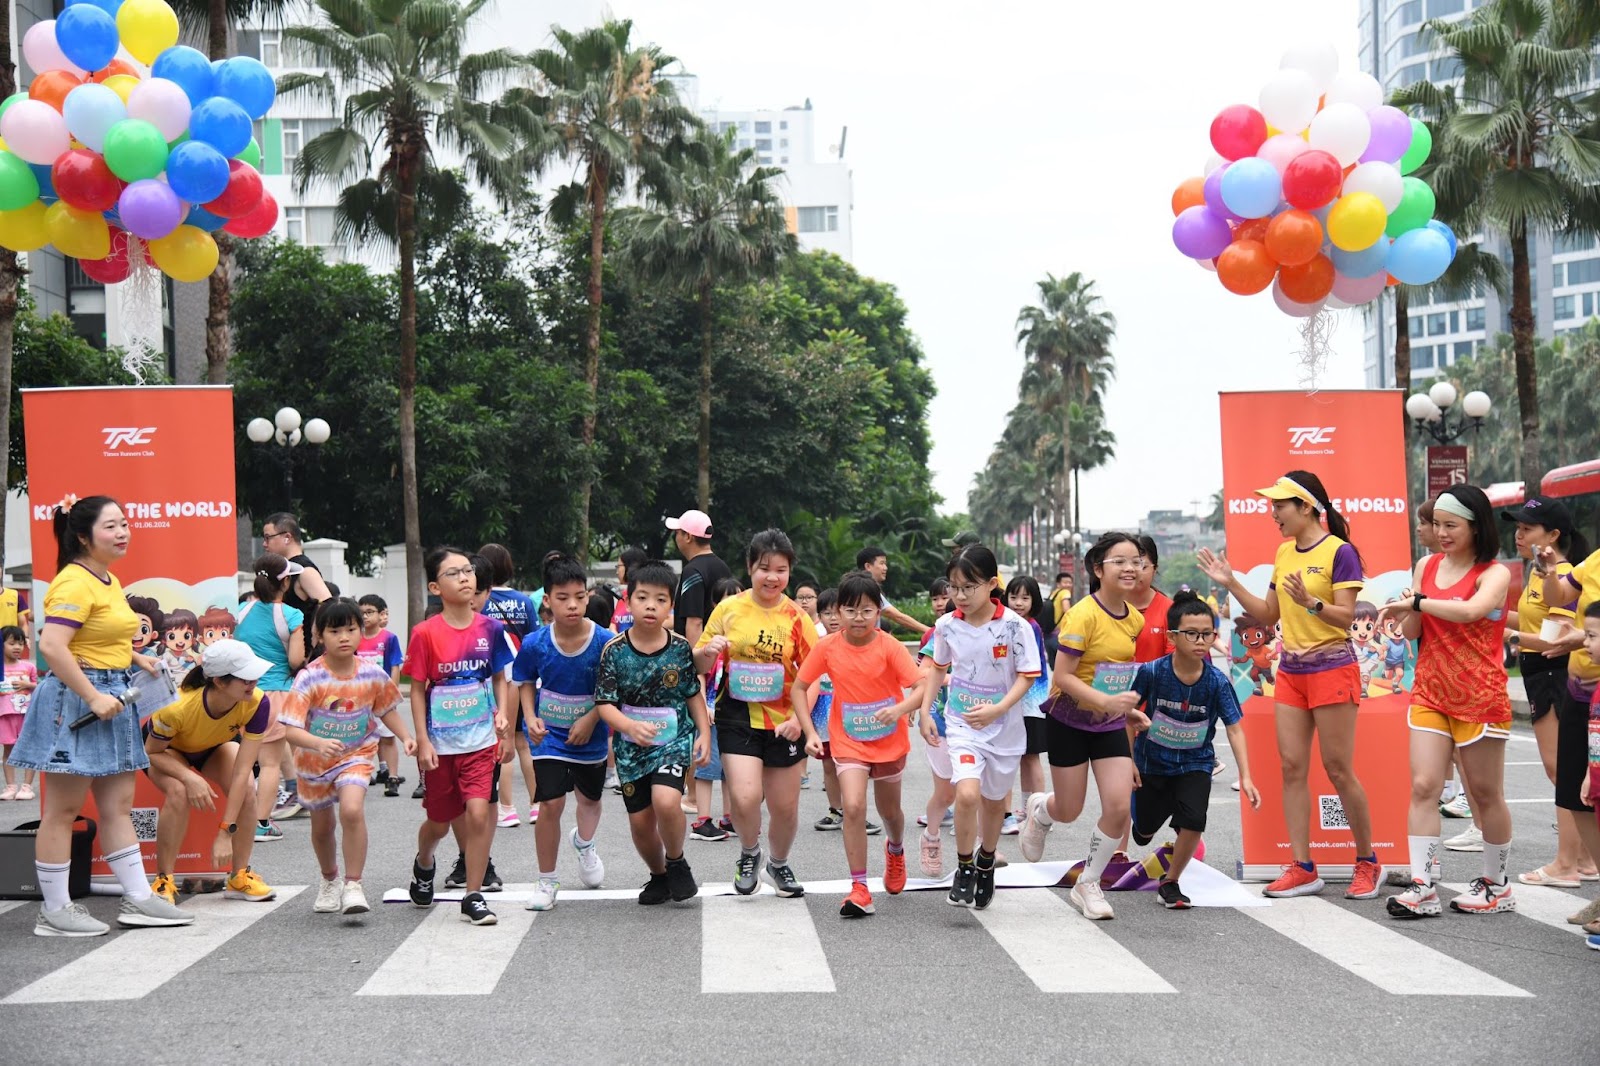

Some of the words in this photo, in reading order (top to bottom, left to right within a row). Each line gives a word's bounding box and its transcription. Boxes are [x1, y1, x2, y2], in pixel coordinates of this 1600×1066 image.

[101, 427, 157, 450] TRC
[1287, 426, 1336, 448] TRC
[1448, 468, 1467, 485] 15
[34, 504, 56, 520] KI
[124, 502, 162, 519] THE
[165, 501, 233, 518] WORLD
[1228, 499, 1268, 514] KIDS
[1345, 498, 1405, 514] WORLD
[134, 521, 170, 529] 01.06.2024
[438, 659, 488, 674] EDURUN
[738, 675, 774, 686] CF1052
[442, 697, 478, 710] CF1056
[958, 692, 993, 706] CF1050
[454, 709, 468, 717] LUCY
[547, 703, 586, 715] CM1164
[323, 721, 359, 732] CF1165
[1159, 725, 1198, 738] CM1055
[657, 764, 683, 778] 25
